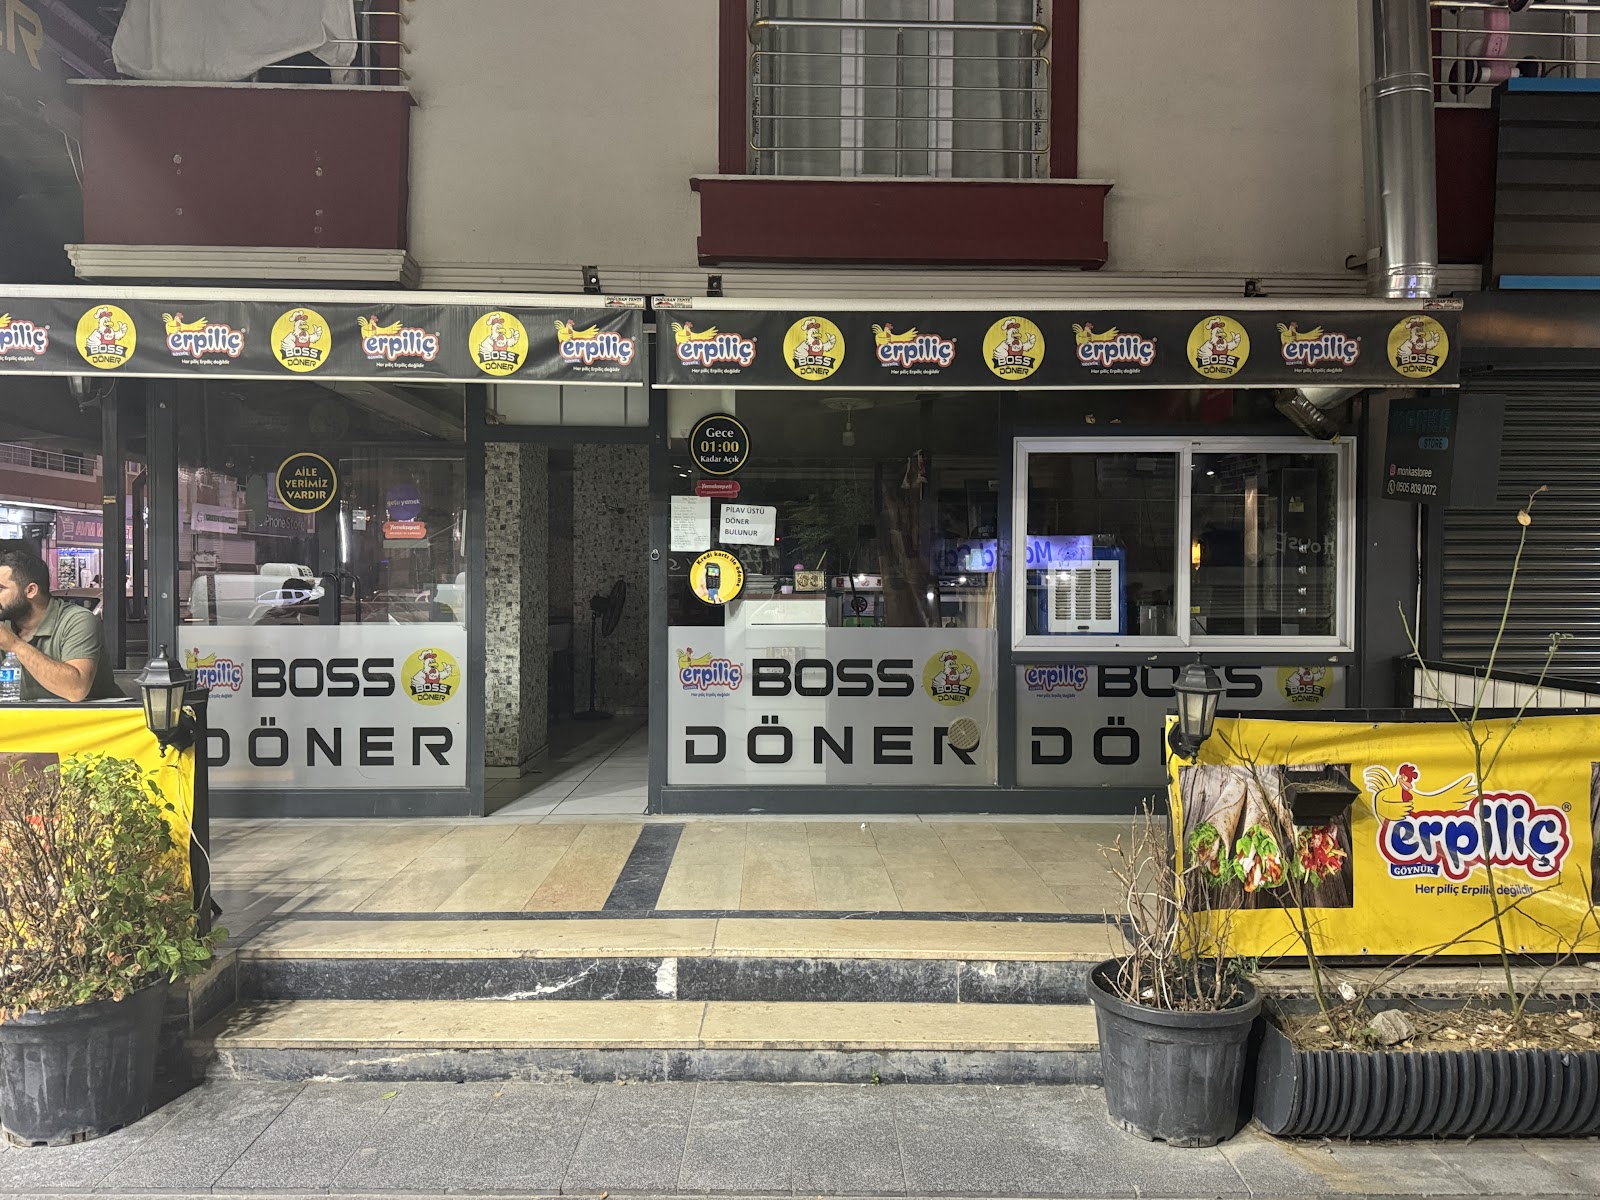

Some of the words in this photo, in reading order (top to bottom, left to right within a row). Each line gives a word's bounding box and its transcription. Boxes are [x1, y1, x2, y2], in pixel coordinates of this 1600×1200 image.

[170, 327, 241, 354] erpiliç
[366, 331, 435, 357] erpiliç
[90, 344, 124, 354] BOSS
[285, 348, 318, 358] BOSS
[563, 335, 631, 362] erpiliç
[680, 337, 752, 363] erpiliç
[880, 338, 951, 364] erpiliç
[1080, 338, 1152, 362] erpiliç
[1286, 336, 1356, 362] erpiliç
[484, 352, 516, 362] BOSS
[798, 356, 831, 366] BOSS
[998, 356, 1031, 366] BOSS
[1202, 355, 1236, 366] BOSS
[1400, 354, 1434, 365] BOSS
[706, 427, 734, 438] Gece
[700, 441, 740, 452] 01:00
[1424, 438, 1443, 448] STORE
[724, 456, 739, 464] Açık
[294, 466, 318, 476] AİLE
[1397, 466, 1432, 477] monkastoree
[285, 477, 328, 488] YERİMİZ
[1396, 482, 1410, 492] 0505
[1410, 483, 1421, 494] 809
[1422, 484, 1437, 495] 0072
[286, 490, 326, 499] VARDIR
[726, 506, 745, 514] PİLAV
[725, 517, 750, 525] DÖNER
[696, 552, 712, 565] Kredi
[196, 663, 240, 687] rpiliç
[252, 658, 395, 697] BOSS
[682, 662, 739, 687] erpiliç
[752, 658, 914, 696] BOSS
[1028, 665, 1085, 688] erpiliç
[416, 683, 447, 693] BOSS
[937, 684, 967, 693] BOSS
[1290, 685, 1321, 694] BOSS
[685, 715, 976, 765] DÖNER
[1390, 804, 1560, 870] erpiliç
[1393, 865, 1434, 875] GÖYNÜK
[1415, 884, 1435, 894] Her
[1437, 884, 1459, 896] piliç
[1497, 884, 1534, 897] değildir
